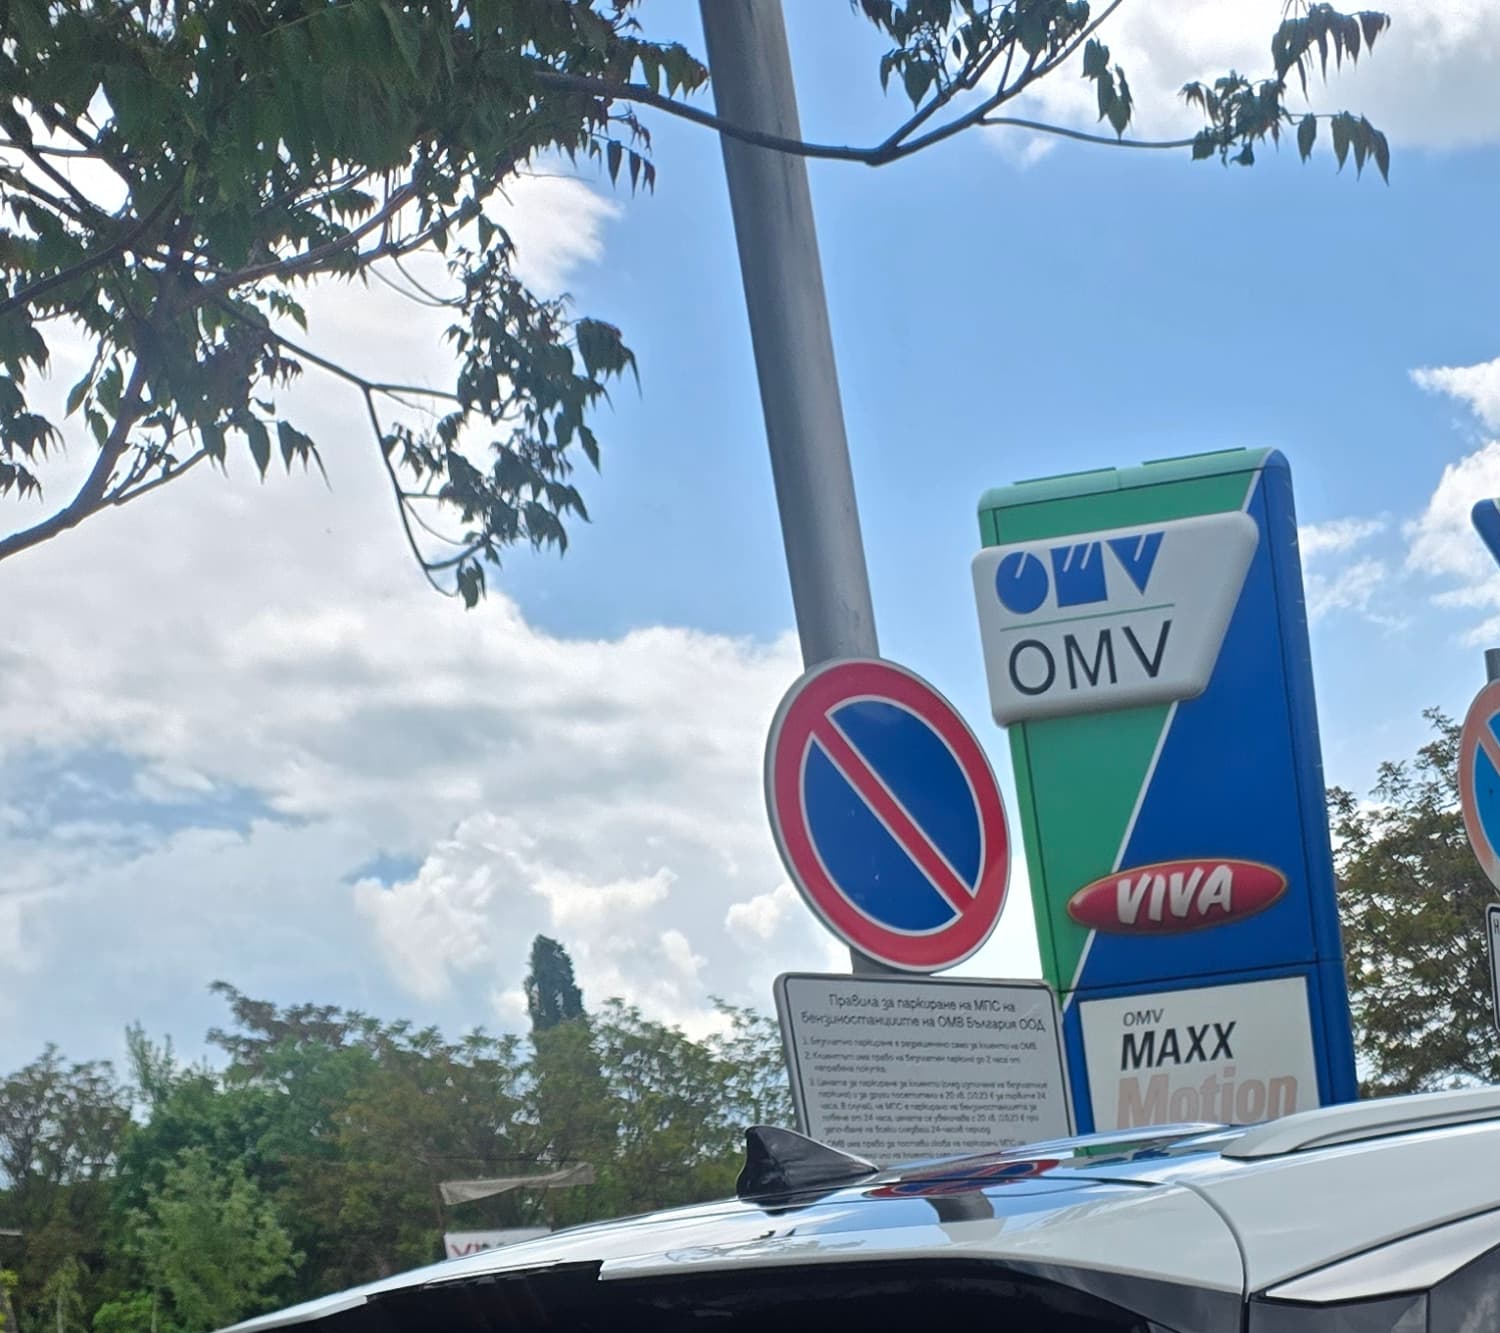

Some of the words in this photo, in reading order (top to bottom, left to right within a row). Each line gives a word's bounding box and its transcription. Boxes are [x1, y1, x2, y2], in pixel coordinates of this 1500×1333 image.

[1008, 619, 1173, 696] OMV
[1116, 864, 1234, 925] VIVA
[829, 993, 879, 1008] Правила
[881, 997, 896, 1011] за
[897, 996, 956, 1012] паркиране
[959, 1000, 973, 1011] на
[975, 998, 1000, 1012] МПС
[1002, 1003, 1016, 1013] на
[922, 1016, 936, 1027] на
[938, 1016, 964, 1029] ОМВ
[1019, 1019, 1046, 1032] ООД
[1122, 1008, 1165, 1027] OMV
[1121, 1021, 1236, 1071] MAXX
[1116, 1067, 1298, 1131] Motion
